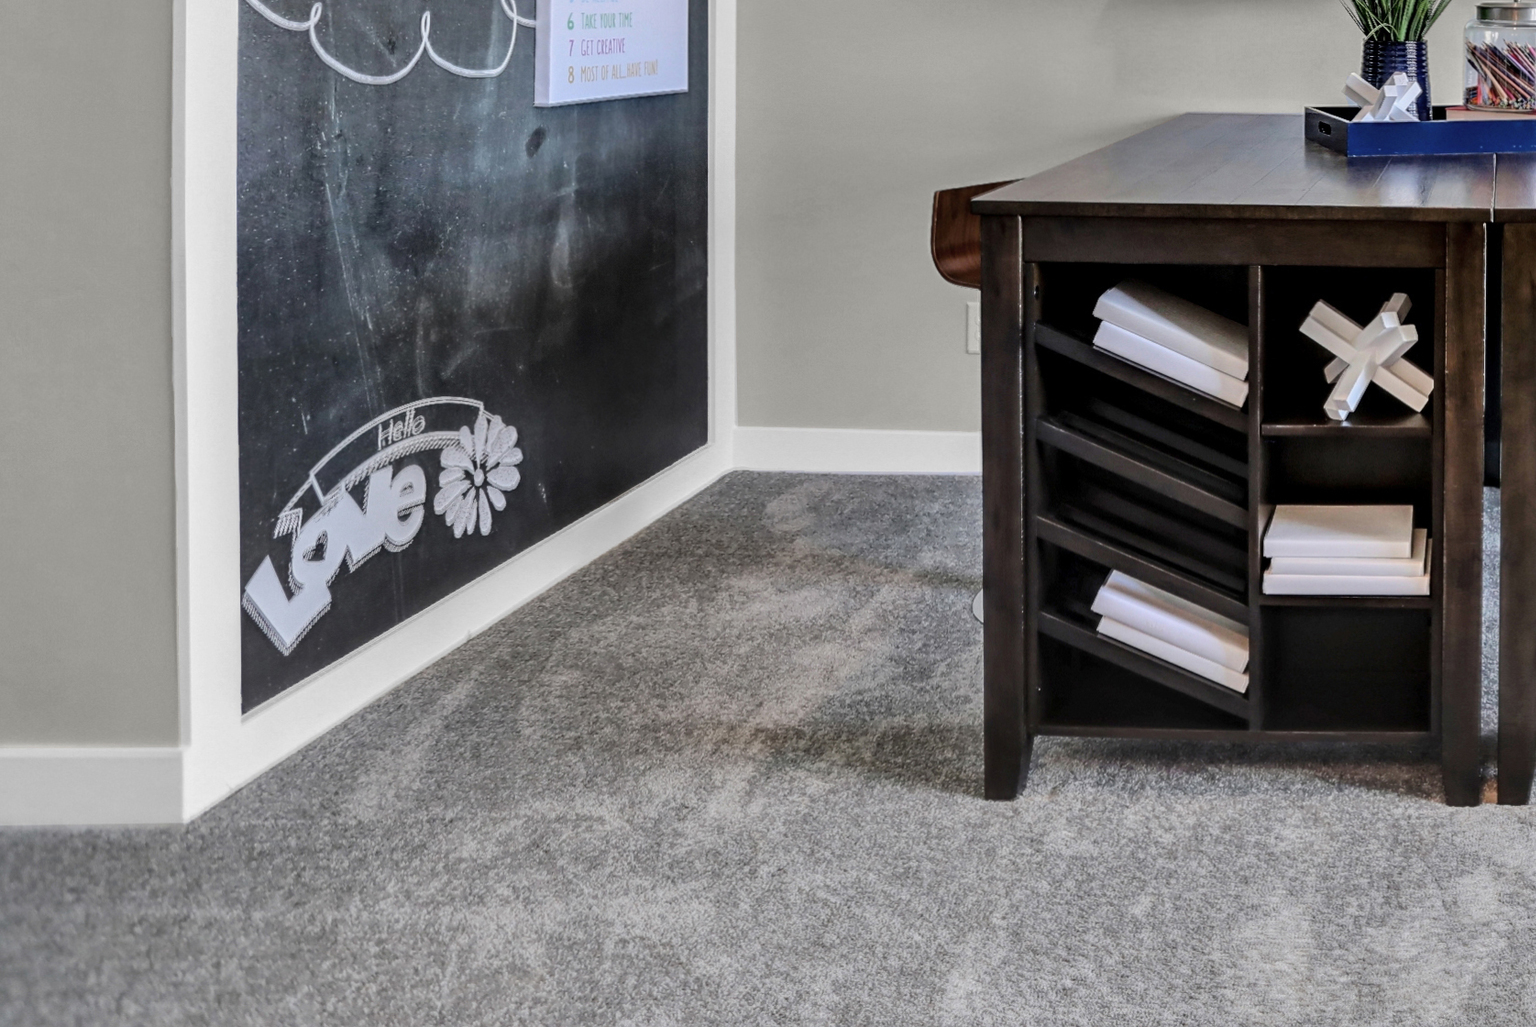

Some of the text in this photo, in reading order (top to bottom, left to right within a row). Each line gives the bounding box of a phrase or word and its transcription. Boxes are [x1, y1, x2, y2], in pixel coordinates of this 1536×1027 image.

[567, 12, 633, 30] 6 TAKE YOUR TIME
[569, 37, 625, 57] 7 GET CREATIVE
[568, 66, 575, 84] 8
[580, 65, 598, 83] MOST
[601, 64, 610, 81] OF
[377, 407, 426, 451] Hello
